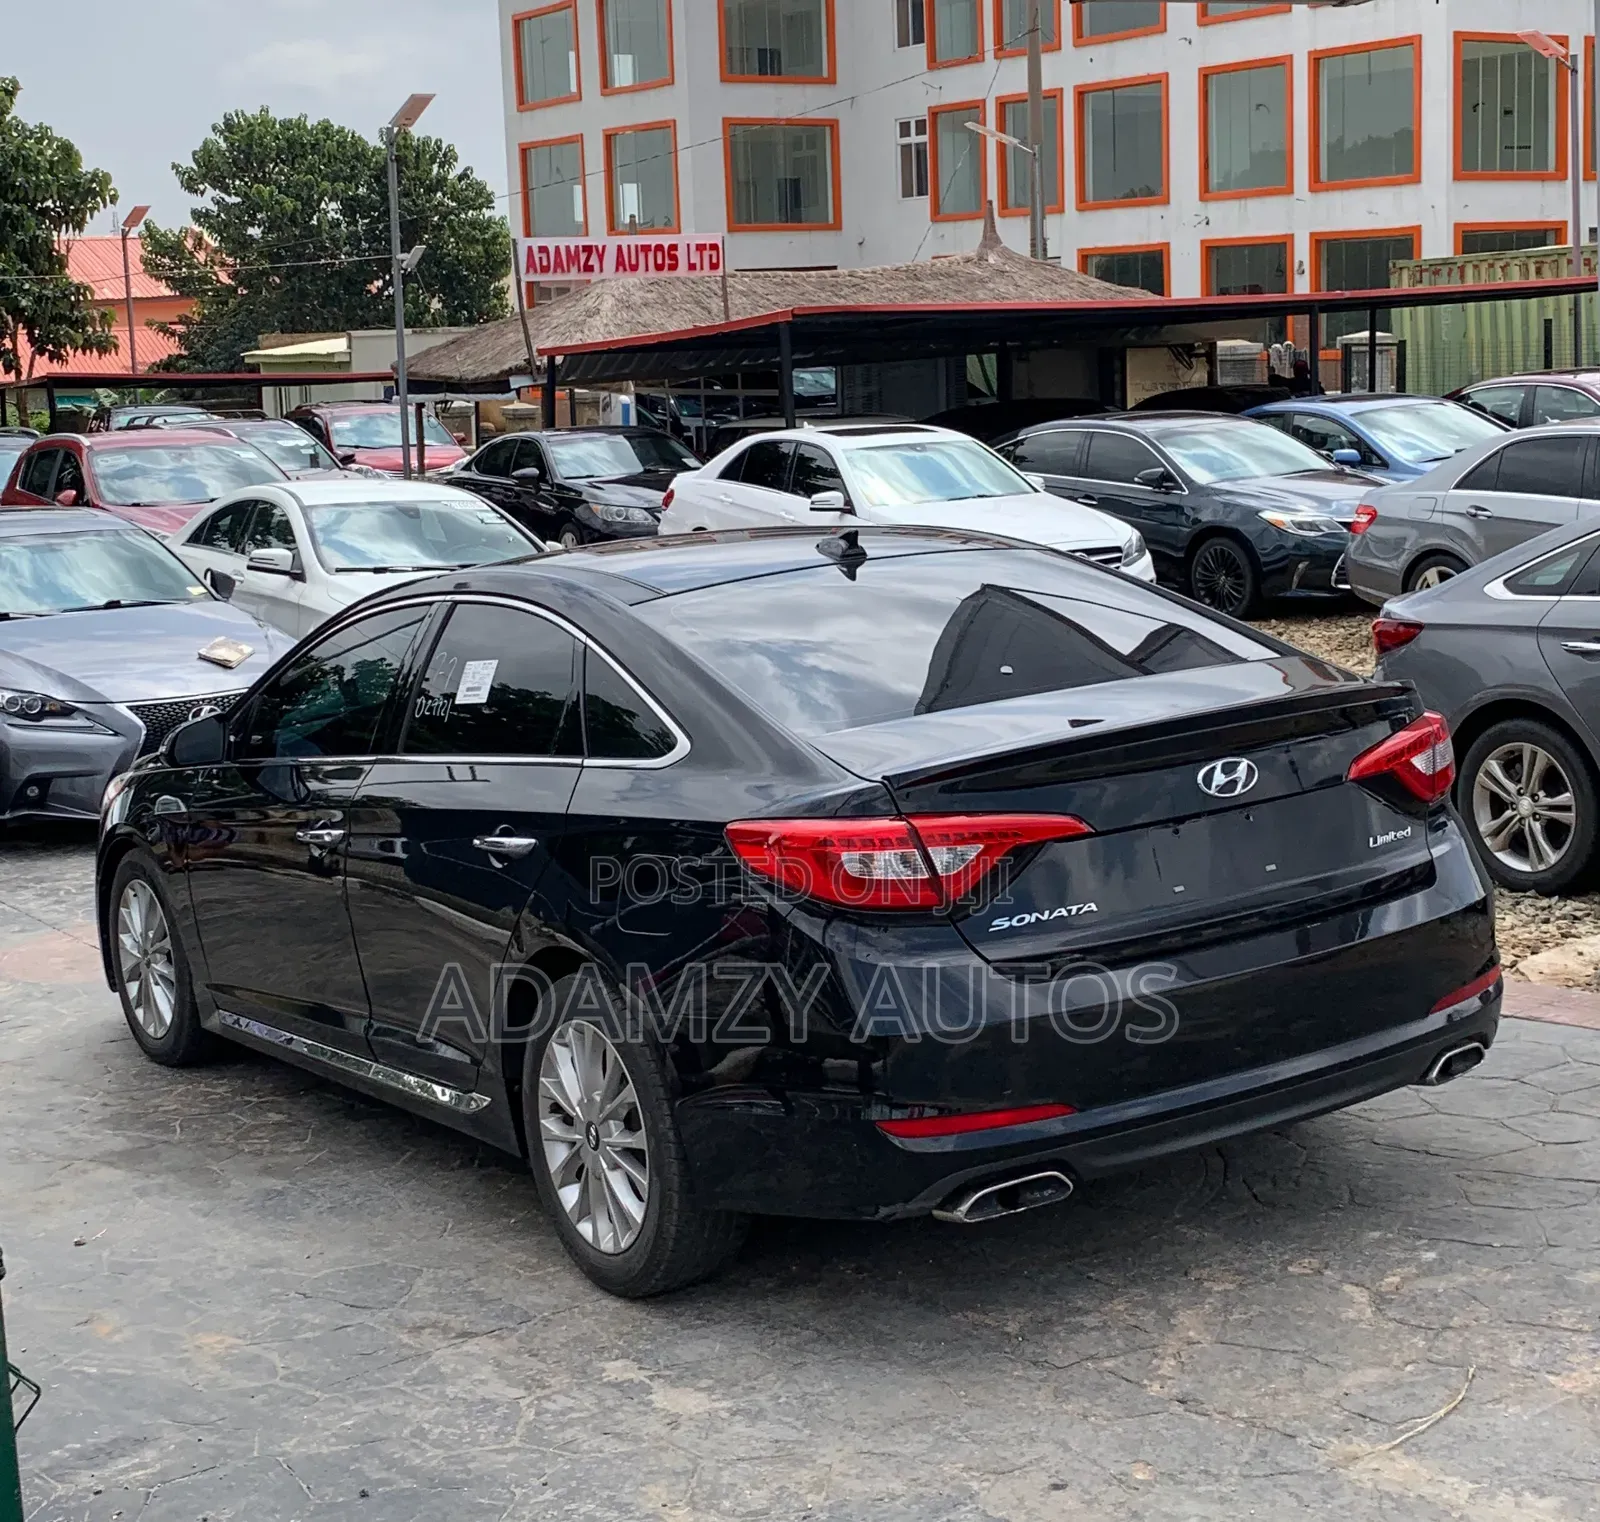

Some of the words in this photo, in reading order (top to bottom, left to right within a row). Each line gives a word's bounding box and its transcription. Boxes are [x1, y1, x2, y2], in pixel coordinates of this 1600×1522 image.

[525, 244, 607, 274] ADAMZY
[615, 243, 679, 273] AUTOS
[686, 243, 721, 272] LTD
[1369, 825, 1411, 848] Limited
[988, 901, 1098, 932] SONATA
